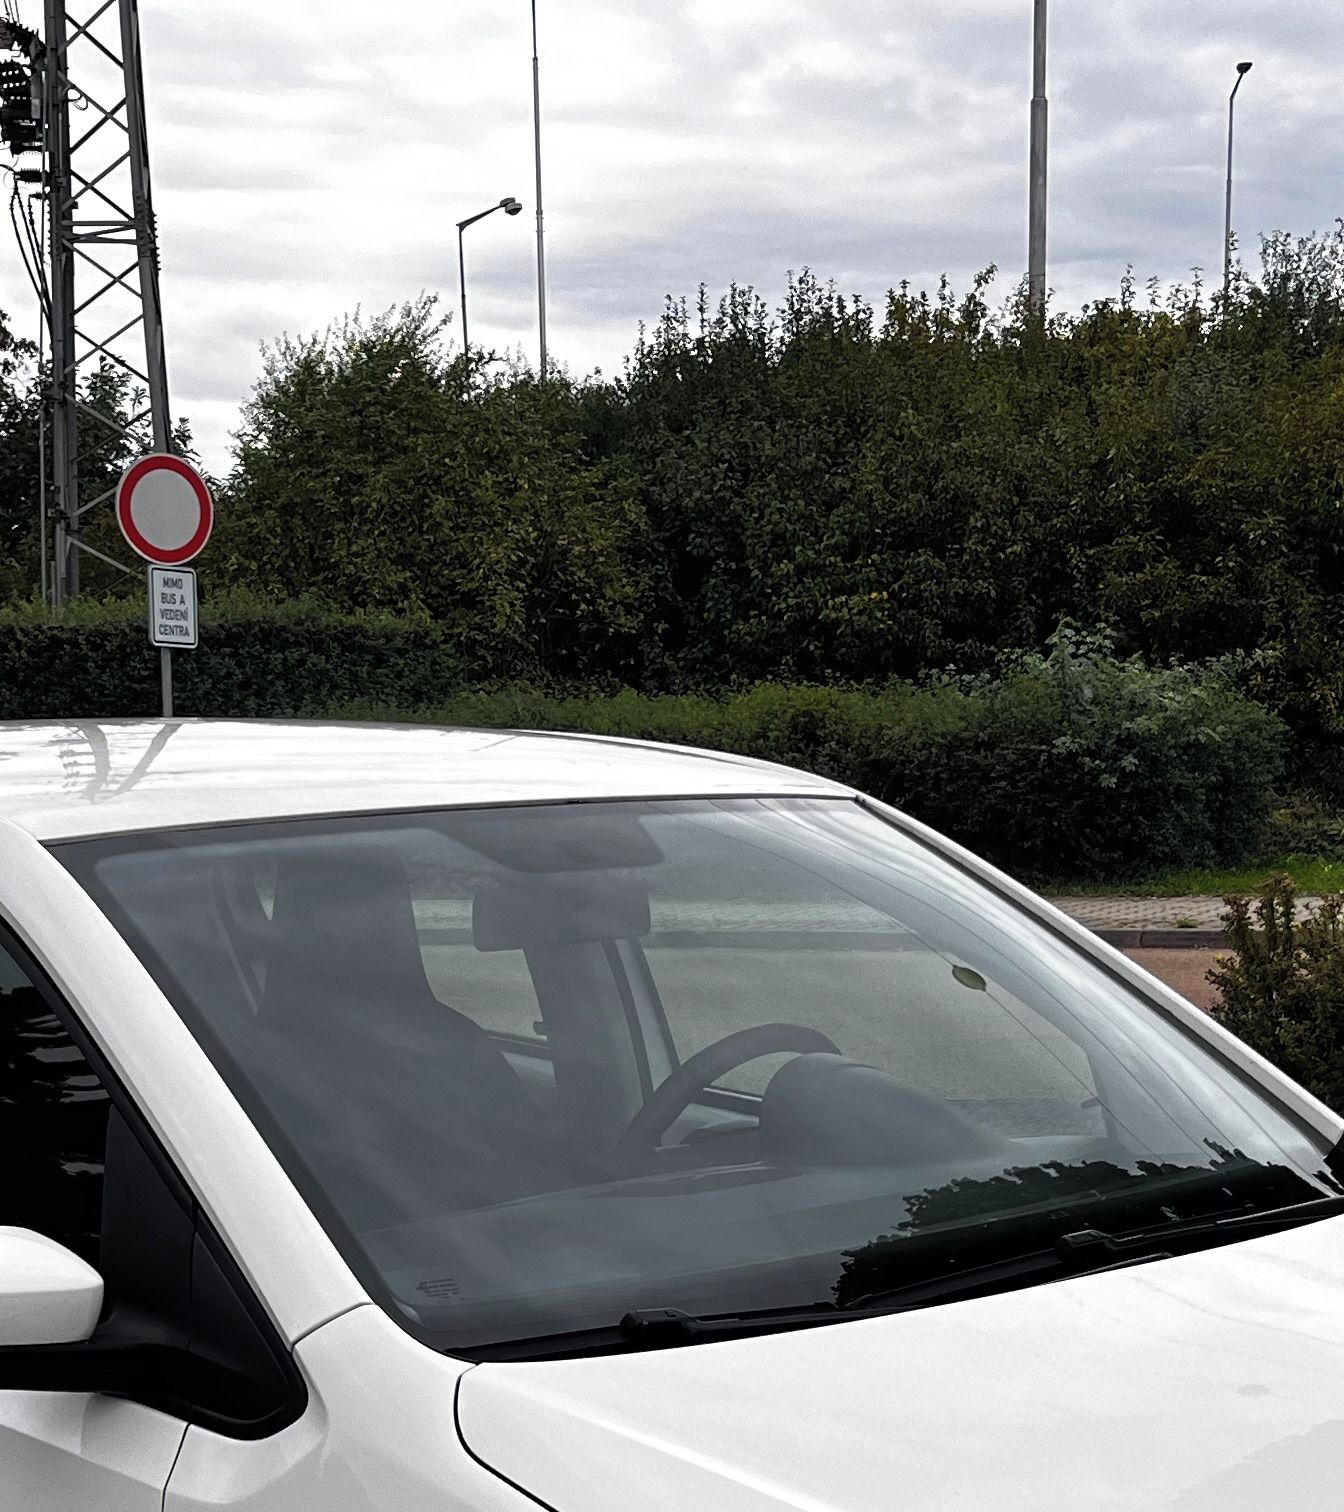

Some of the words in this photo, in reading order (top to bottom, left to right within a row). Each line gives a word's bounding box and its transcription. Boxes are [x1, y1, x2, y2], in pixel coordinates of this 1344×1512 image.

[162, 577, 183, 590] MIMO
[161, 592, 177, 605] BUS
[179, 594, 186, 605] A
[159, 606, 189, 621] VEDENÍ
[158, 624, 190, 637] CENTRA
